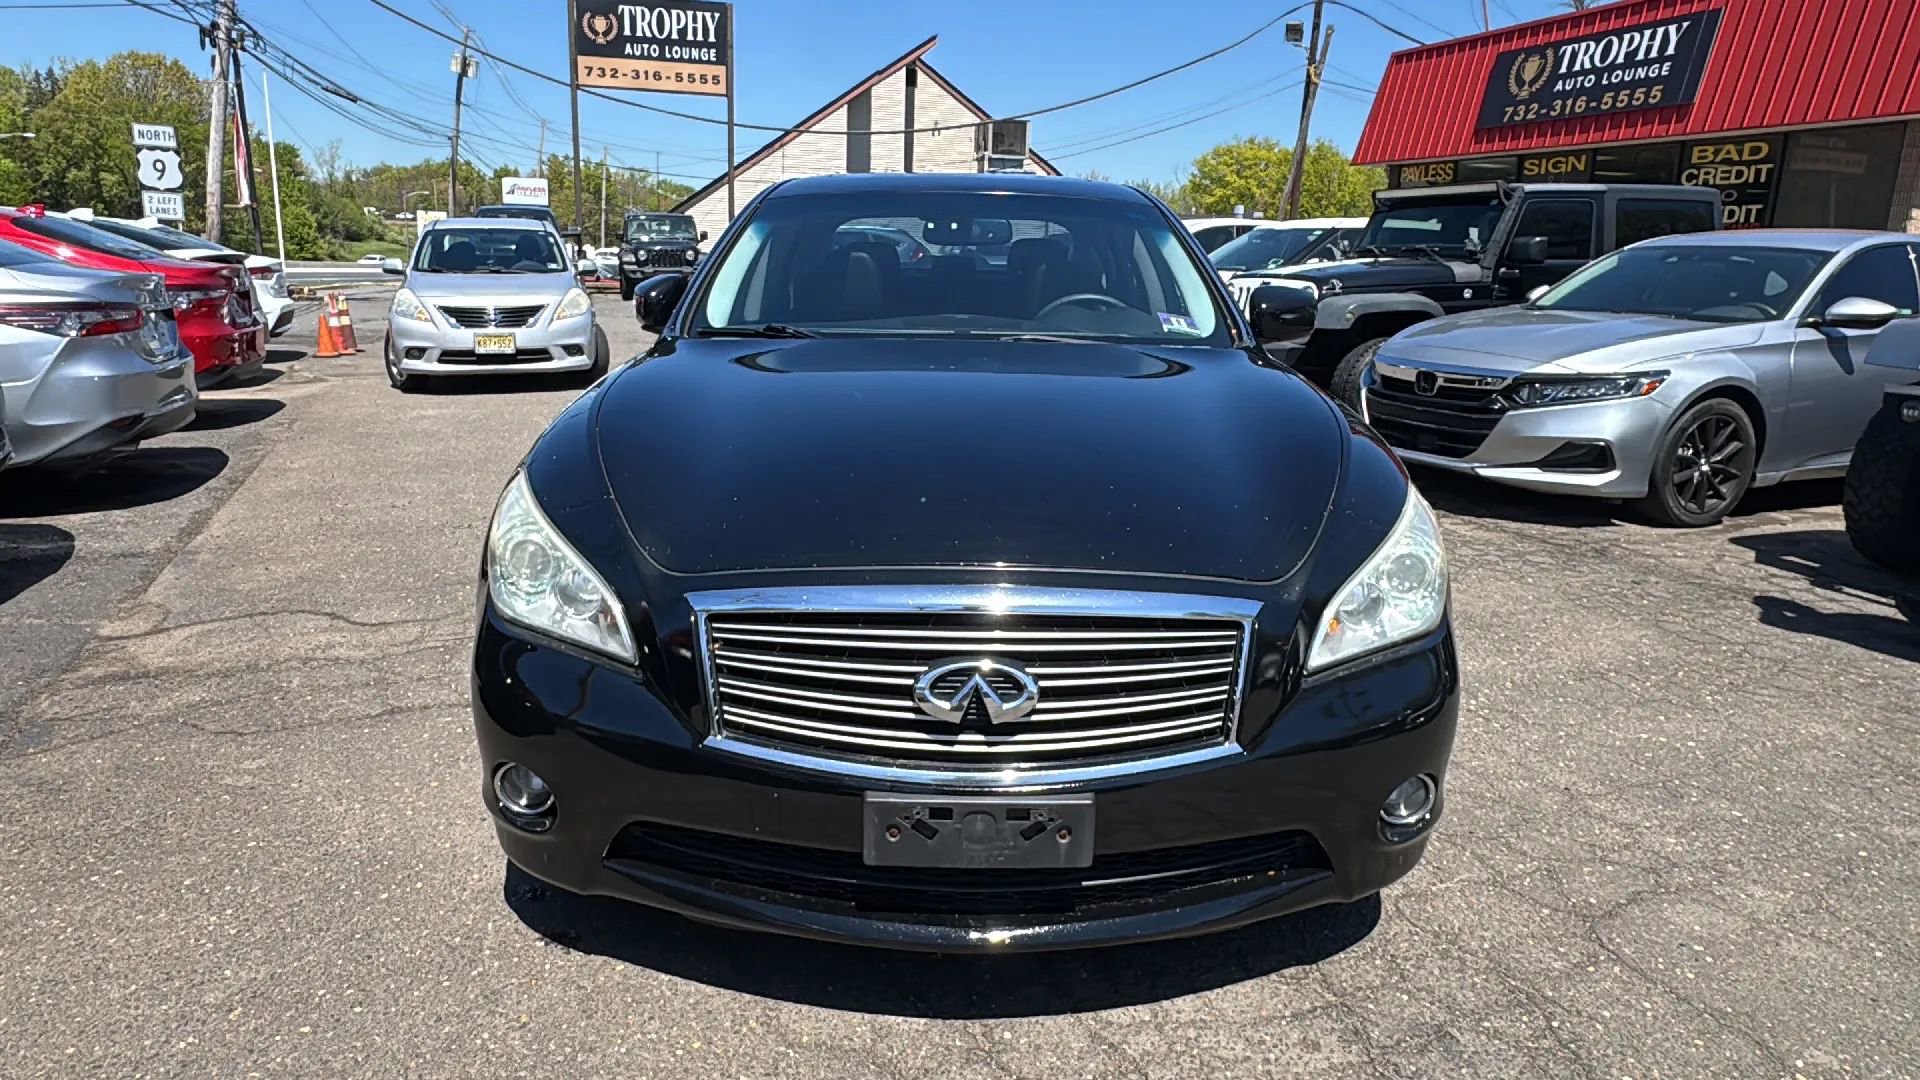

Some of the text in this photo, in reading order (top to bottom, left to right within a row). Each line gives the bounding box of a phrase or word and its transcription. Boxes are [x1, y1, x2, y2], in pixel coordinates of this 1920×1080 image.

[618, 5, 720, 42] TROPHY
[624, 43, 717, 61] AUTO LOUNGE
[1558, 21, 1691, 74] TROPHY
[584, 65, 721, 85] 732-316-5555
[1553, 62, 1672, 93] AUTO LOUNGE
[1503, 85, 1664, 123] 732-316-5555
[137, 129, 175, 142] NORTH
[1691, 141, 1769, 164] BAD
[152, 158, 166, 181] 9
[1401, 163, 1455, 182] PAYLESS
[1523, 155, 1587, 176] SIGN
[1680, 163, 1775, 186] CREDIT
[147, 195, 177, 206] 2 LEFT
[1721, 189, 1738, 201] O
[149, 206, 178, 216] LANES
[1721, 204, 1764, 224] DIT
